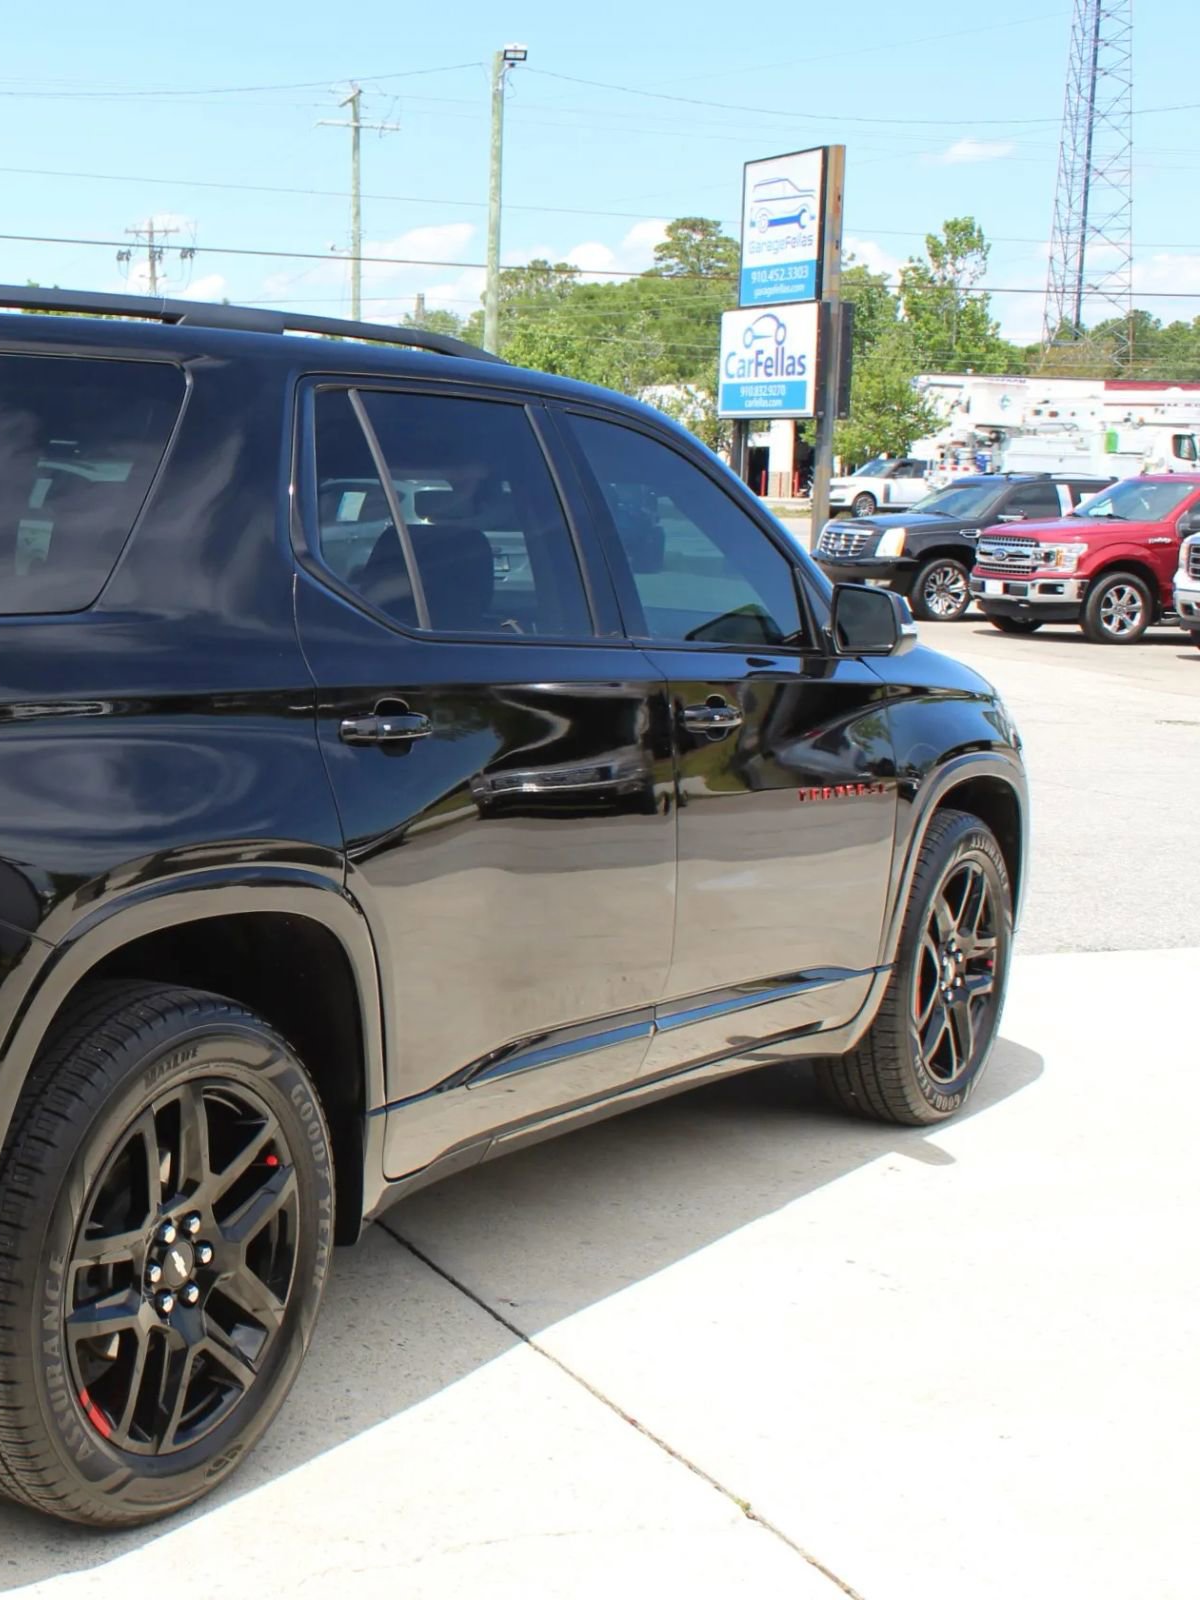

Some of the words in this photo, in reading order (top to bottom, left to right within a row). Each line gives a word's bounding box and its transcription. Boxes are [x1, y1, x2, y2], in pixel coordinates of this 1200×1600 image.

[748, 233, 813, 255] GarageFellas
[725, 347, 806, 378] CarFellas
[43, 1255, 93, 1463] ASSURANCE
